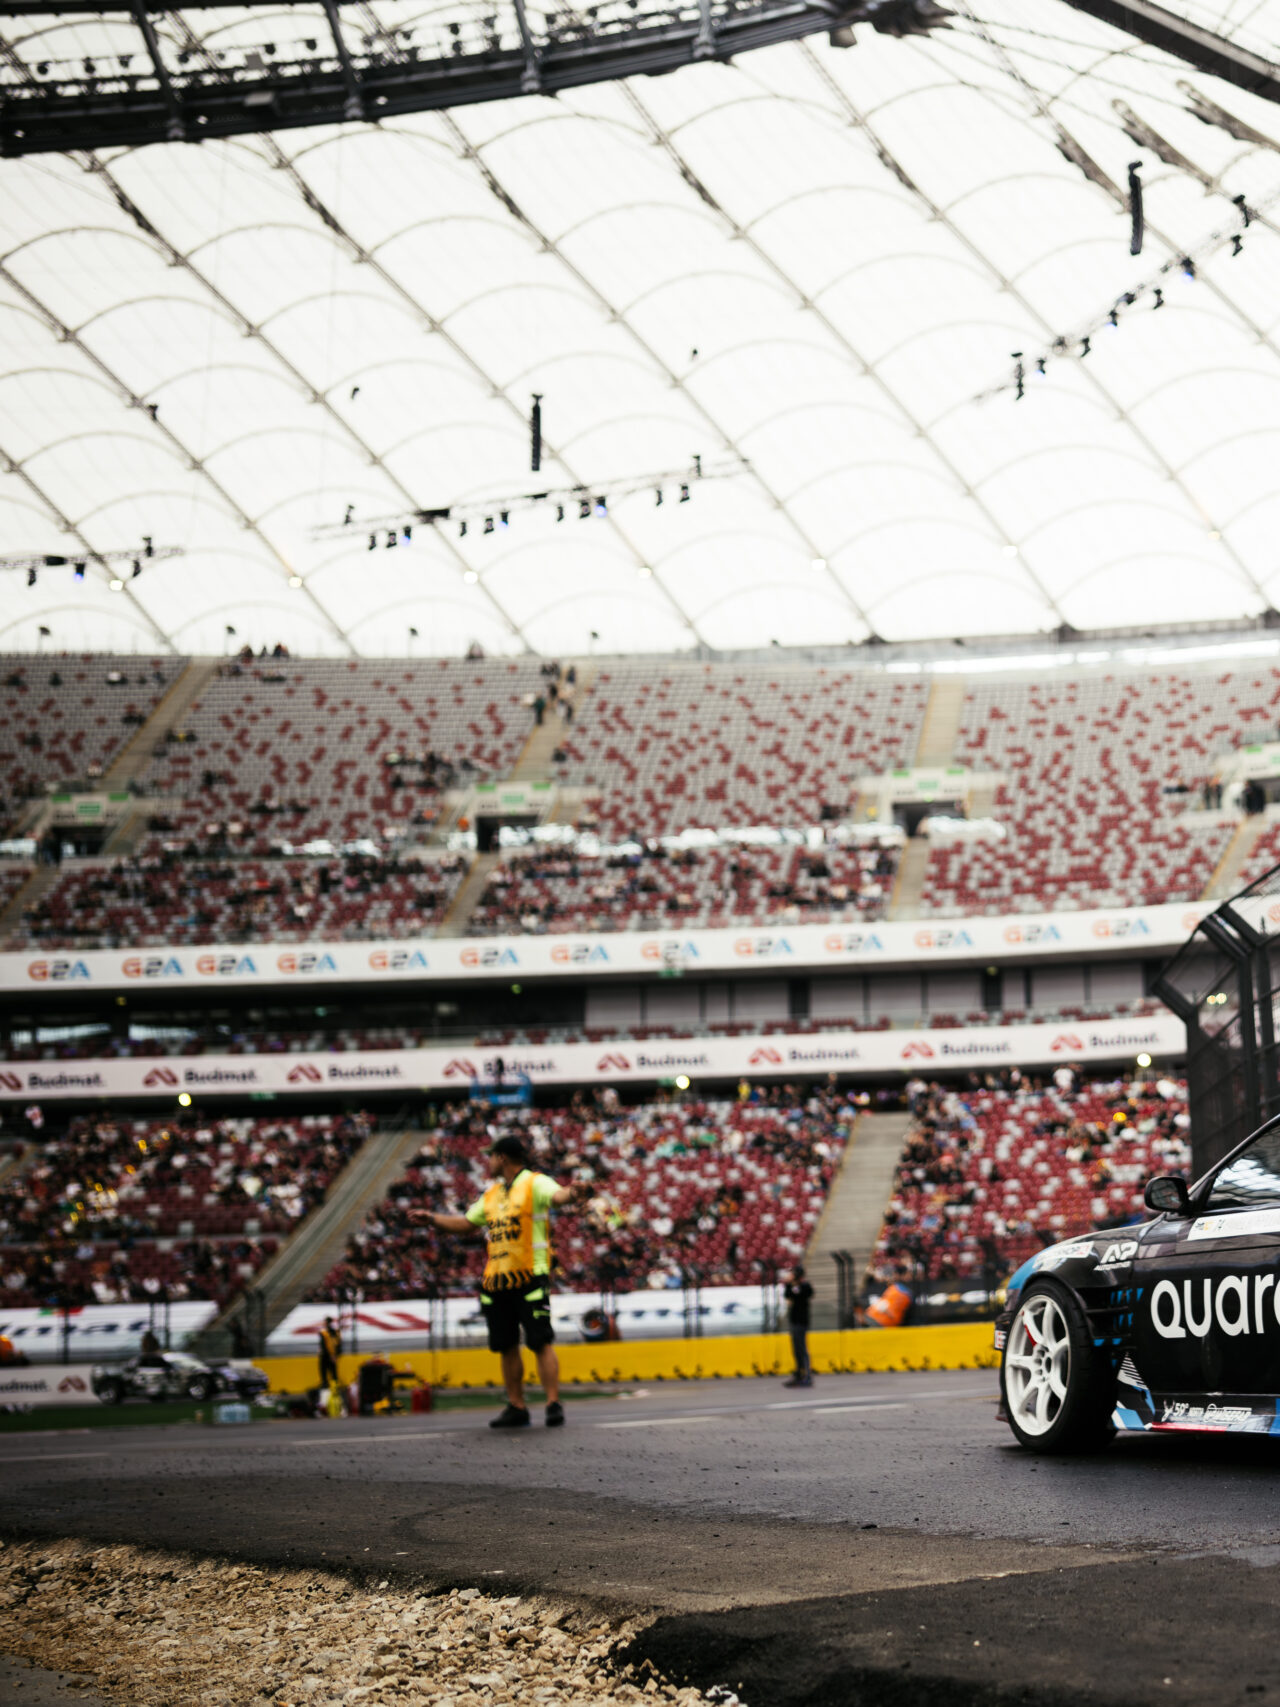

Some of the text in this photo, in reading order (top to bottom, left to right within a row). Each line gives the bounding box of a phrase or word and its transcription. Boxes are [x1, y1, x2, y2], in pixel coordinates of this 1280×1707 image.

[1004, 925, 1062, 945] G2A
[1092, 918, 1151, 939] G2A
[734, 937, 794, 957] G2A
[825, 933, 884, 953] G2A
[914, 930, 974, 949] G2A
[368, 950, 429, 971] G2A
[459, 947, 520, 968] G2A
[550, 944, 610, 964] G2A
[641, 941, 699, 960] G2A
[27, 960, 91, 981] G2A
[122, 956, 184, 978] G2A
[196, 954, 259, 976] G2A
[276, 952, 338, 974] G2A
[1100, 1242, 1138, 1264] AP
